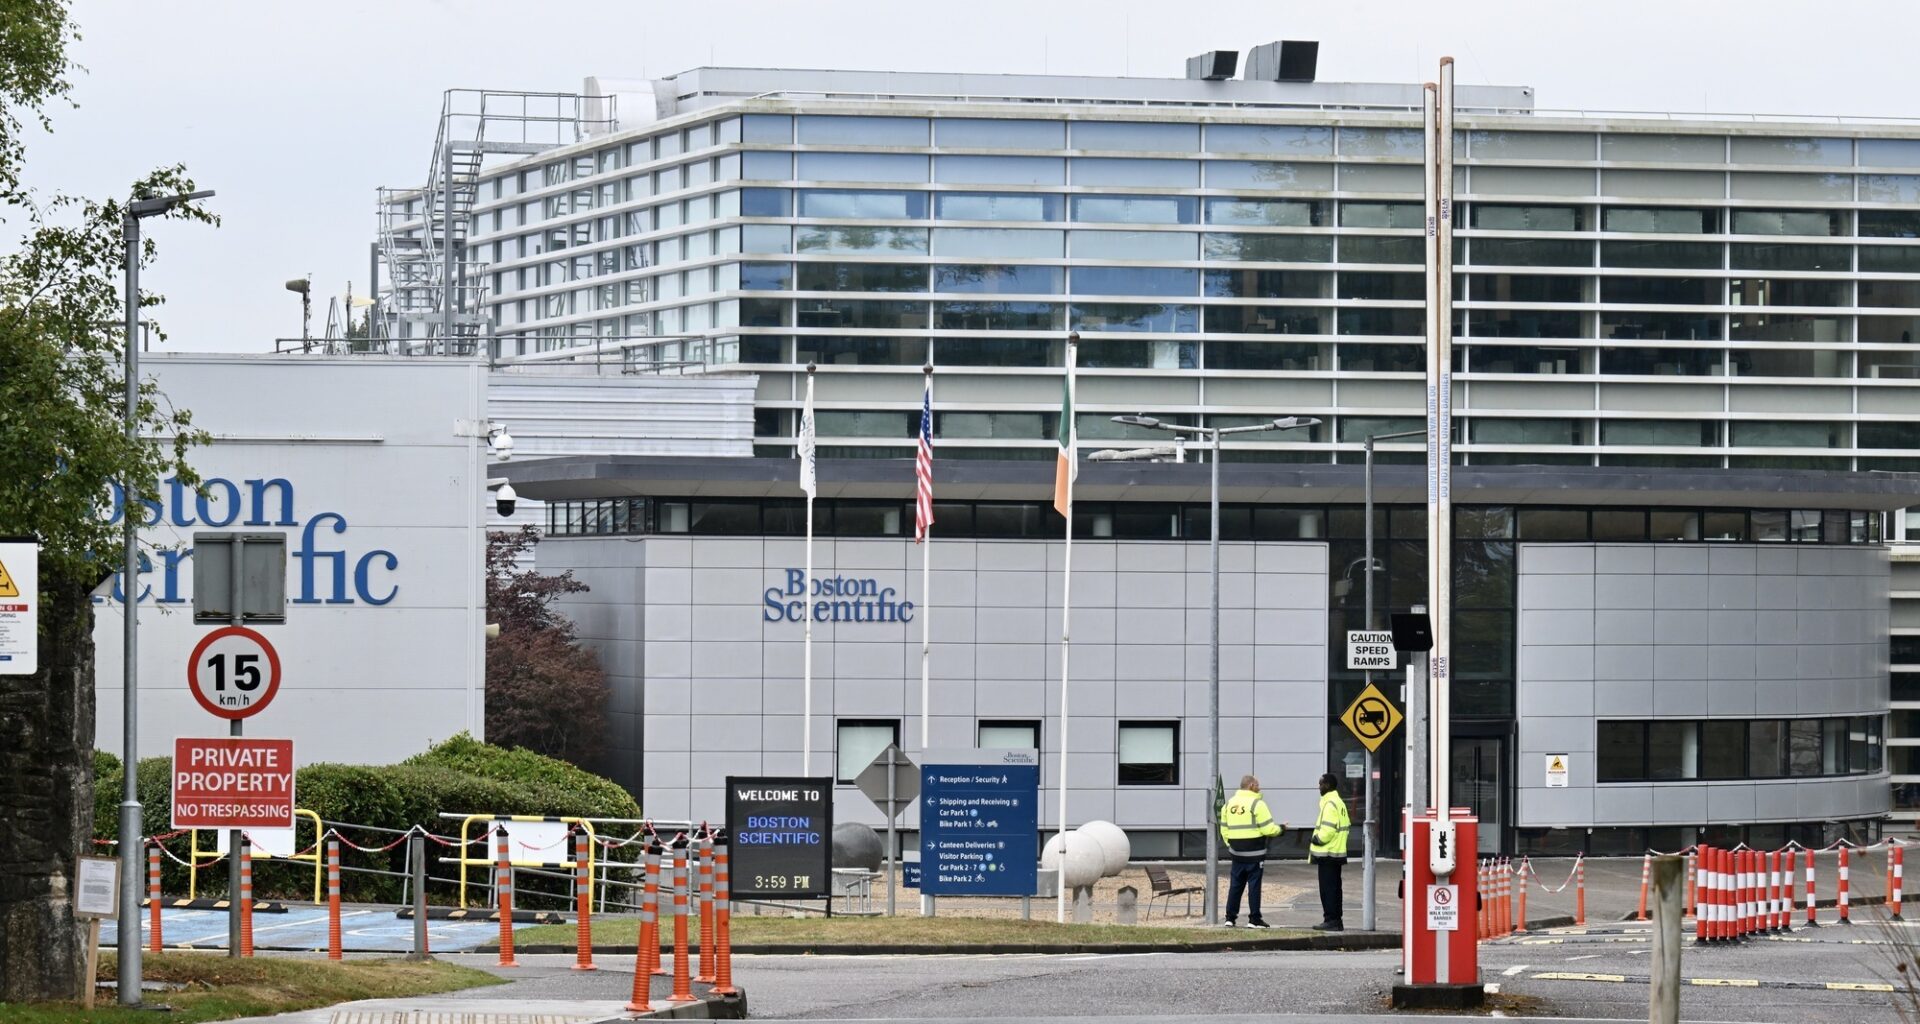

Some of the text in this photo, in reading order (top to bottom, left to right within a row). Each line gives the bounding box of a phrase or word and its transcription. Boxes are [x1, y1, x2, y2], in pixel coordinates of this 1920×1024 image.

[1429, 385, 1436, 397] DO
[1440, 441, 1448, 465] WALK
[1429, 470, 1437, 504] BARRIER
[78, 466, 299, 527] oston
[785, 568, 879, 596] Boston
[1350, 633, 1393, 642] CAUTION
[1355, 646, 1389, 655] SPEED
[1353, 657, 1390, 666] RAMPS
[207, 653, 261, 691] 15
[219, 693, 250, 707] km/h
[191, 747, 278, 768] PRIVATE
[177, 772, 291, 792] PROPERTY
[939, 776, 970, 784] Reception
[975, 776, 1000, 785] Security
[738, 790, 820, 801] WELCOME TO
[939, 798, 967, 806] Shipping
[980, 798, 1010, 806] Receiving
[177, 803, 289, 818] NO TRESPASSING
[748, 816, 809, 828] BOSTON
[939, 820, 953, 828] Bike
[953, 820, 967, 828] Park
[739, 832, 820, 844] SCIENTIFIC
[939, 841, 996, 849] Canteen Deliveries
[960, 853, 984, 861] Parking
[755, 875, 810, 889] 3:59 PM
